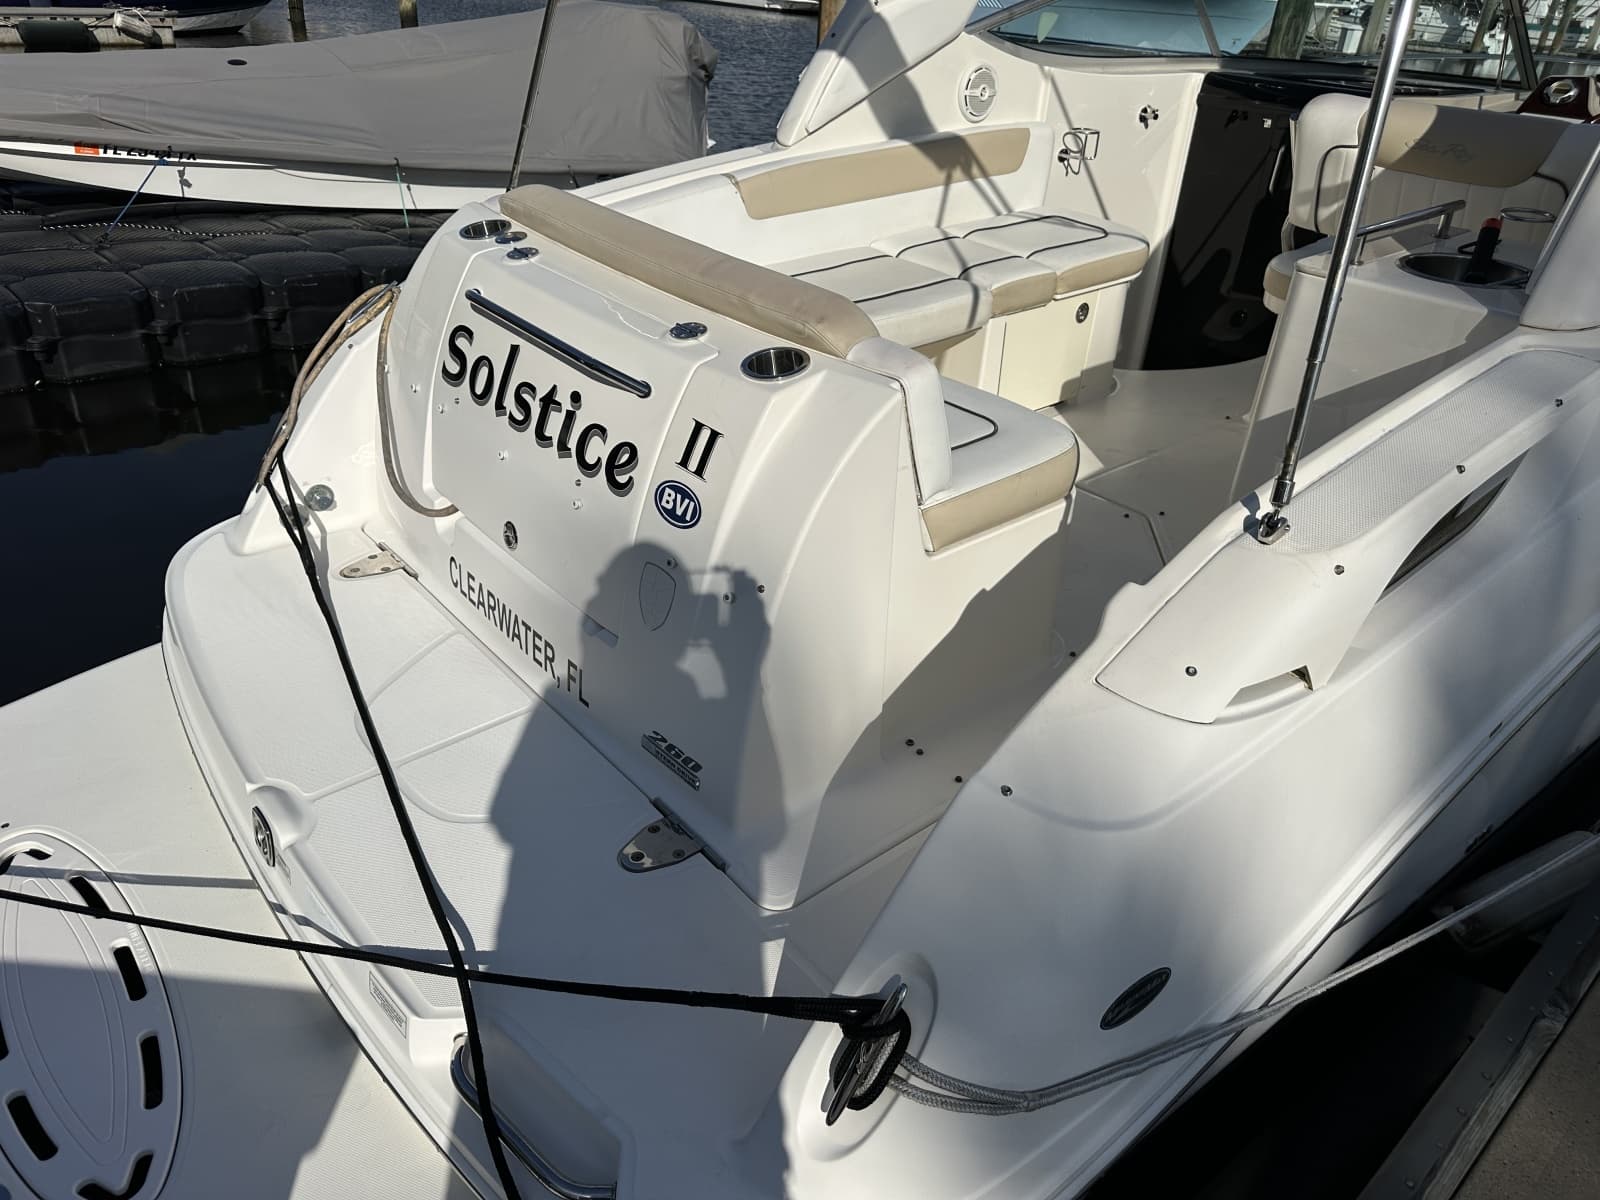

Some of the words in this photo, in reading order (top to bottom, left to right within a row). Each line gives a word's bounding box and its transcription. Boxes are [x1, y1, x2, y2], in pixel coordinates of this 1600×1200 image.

[441, 324, 639, 497] Solstice
[675, 418, 724, 482] II
[660, 486, 696, 522] BVI
[449, 556, 561, 689] CLEARWATER,
[567, 658, 590, 709] FL
[647, 730, 703, 773] 260
